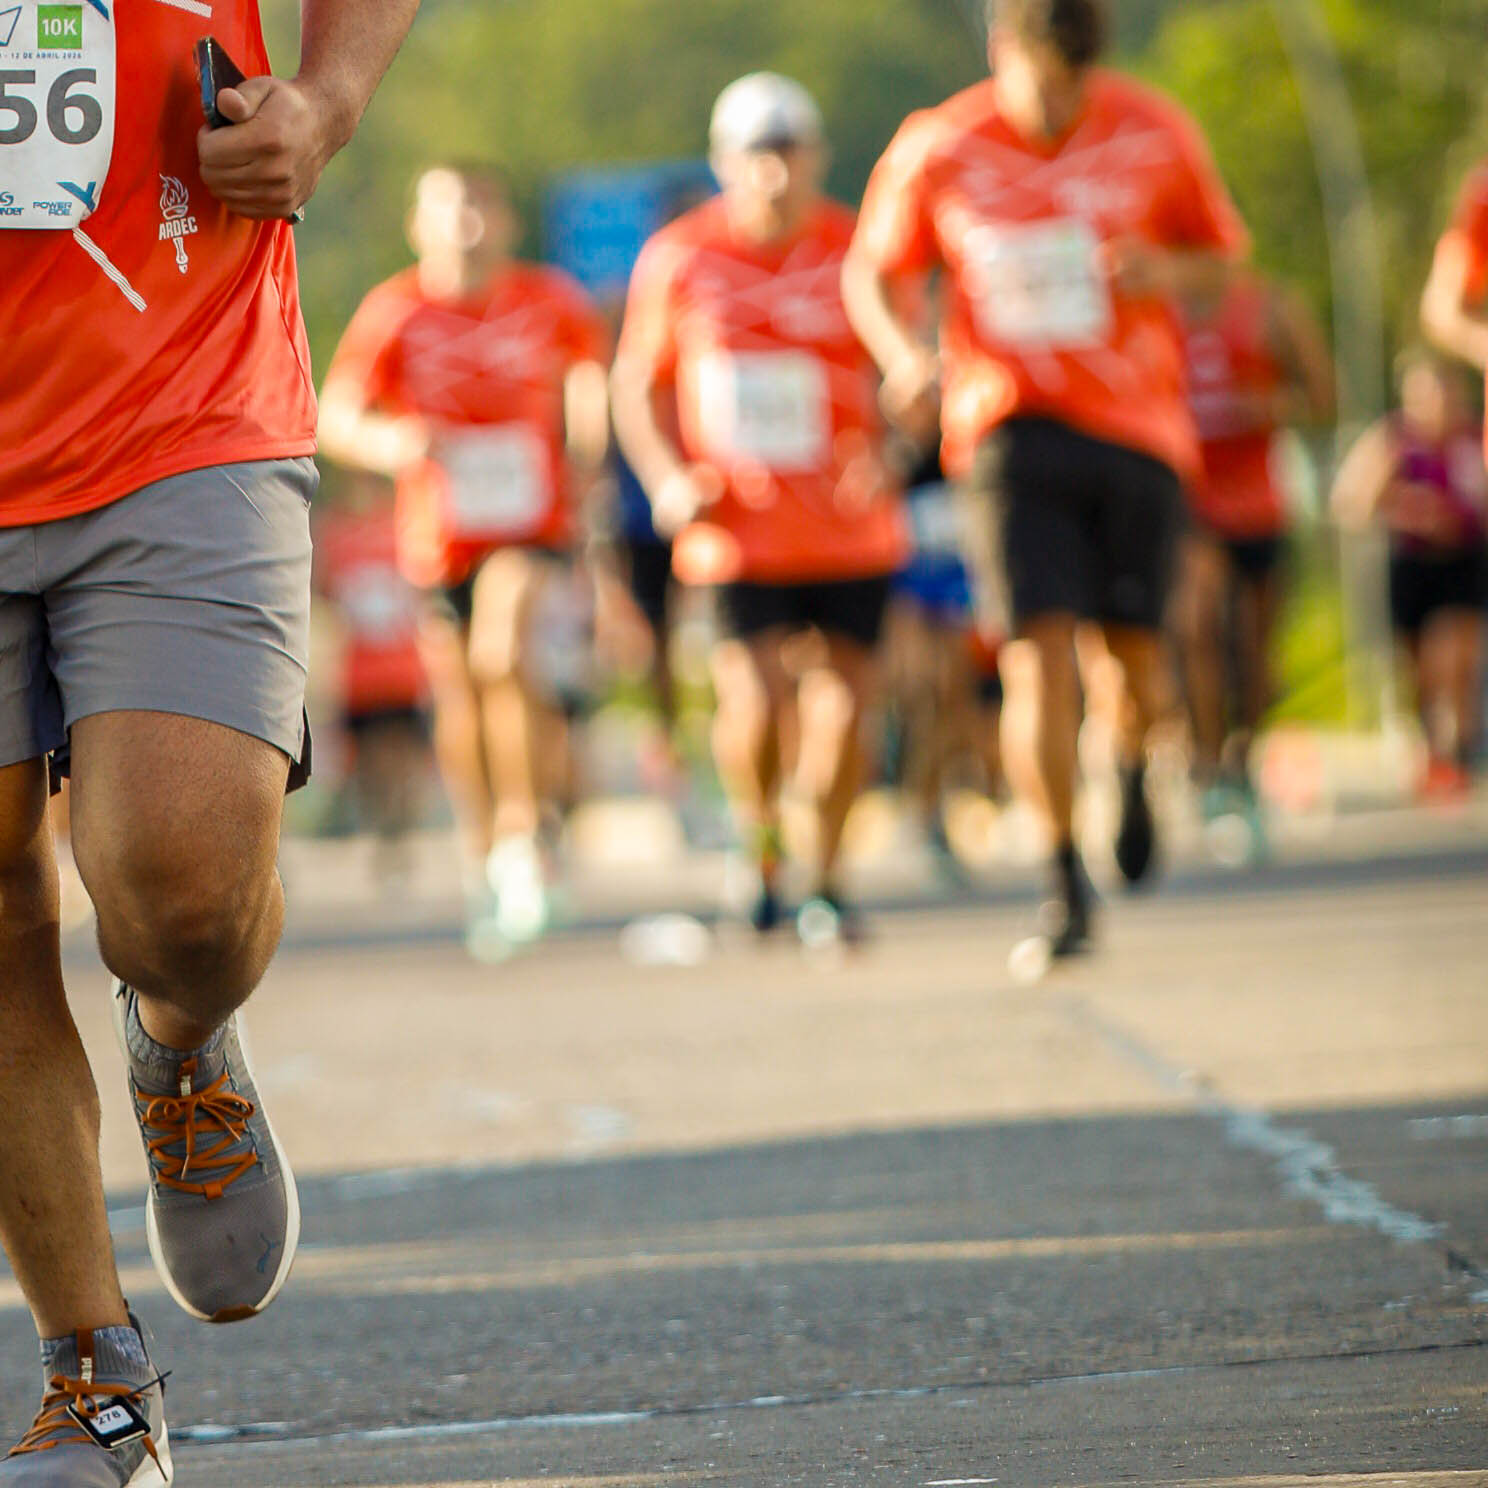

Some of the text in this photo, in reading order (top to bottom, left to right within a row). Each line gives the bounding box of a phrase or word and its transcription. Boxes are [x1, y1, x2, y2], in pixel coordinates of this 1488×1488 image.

[41, 18, 78, 36] 10K
[36, 52, 61, 60] ABRIL
[32, 201, 72, 210] POWER
[158, 216, 198, 240] ARDEC
